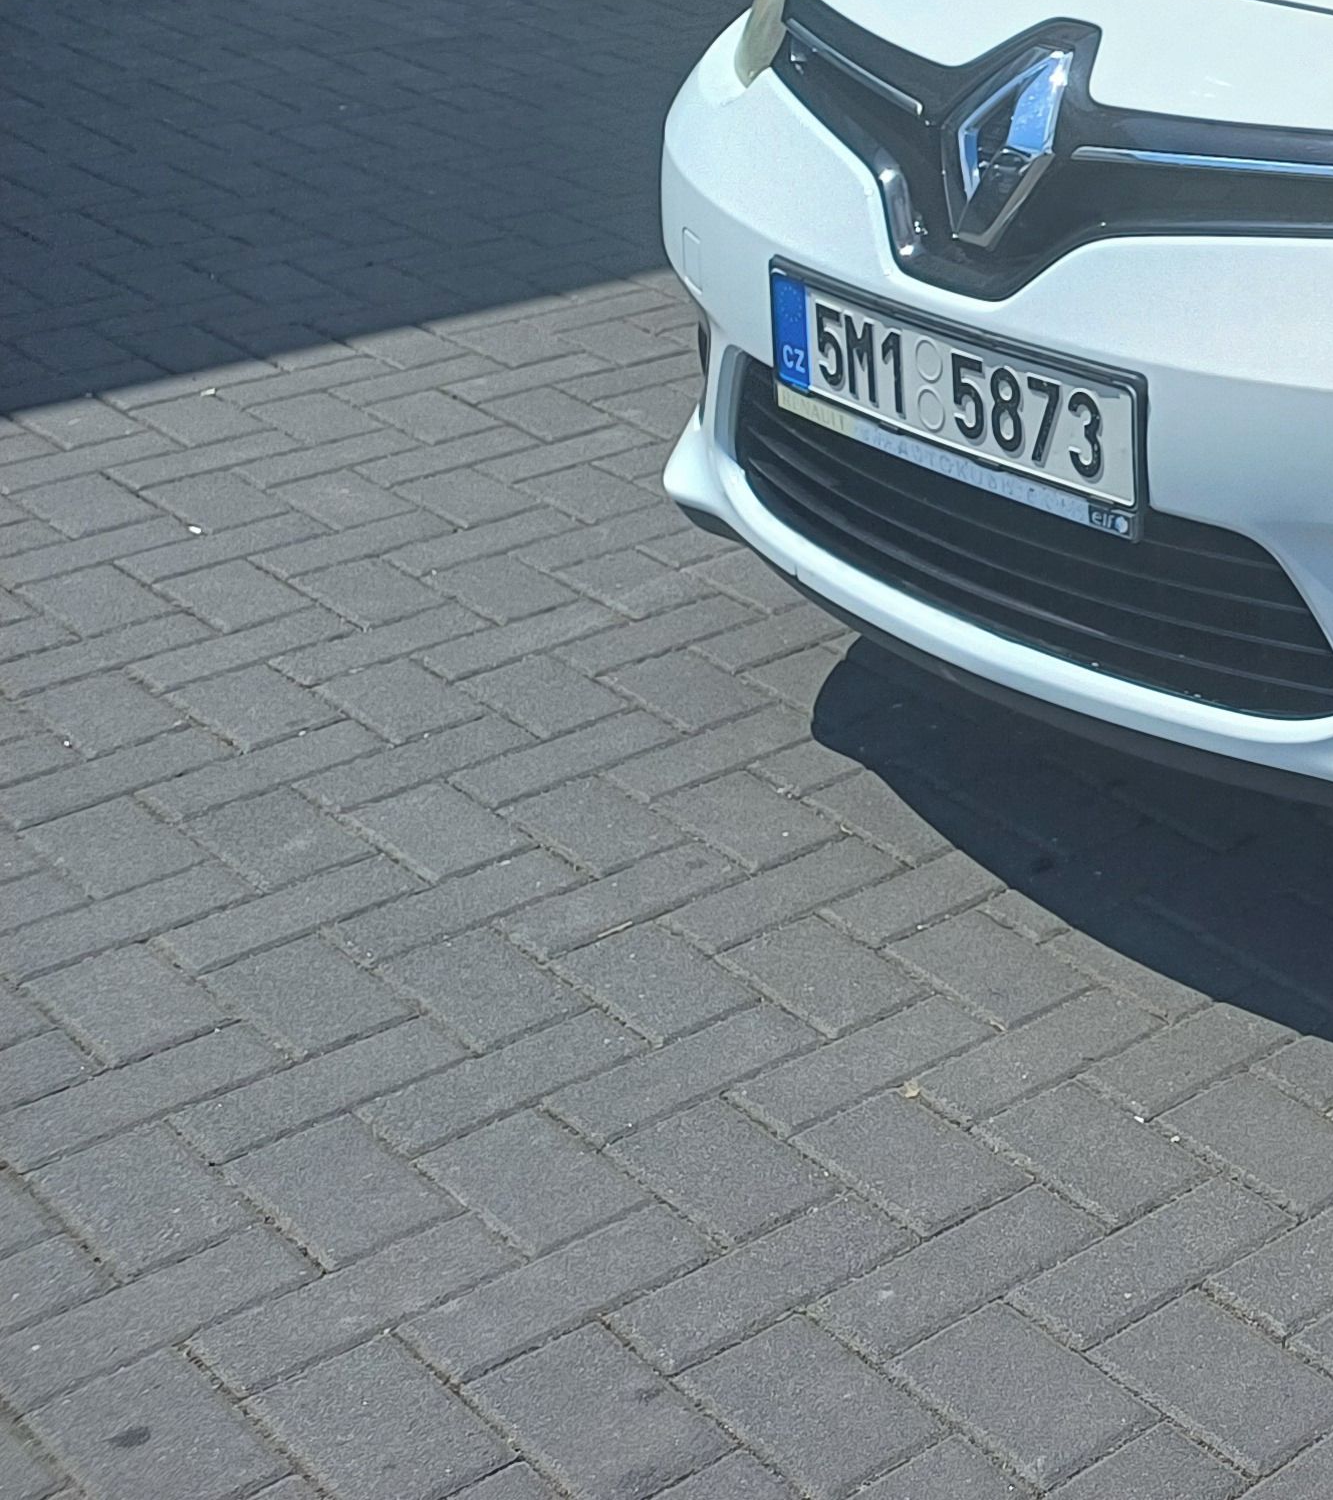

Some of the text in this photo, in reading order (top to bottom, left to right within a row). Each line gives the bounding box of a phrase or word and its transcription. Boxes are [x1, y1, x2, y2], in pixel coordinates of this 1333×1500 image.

[783, 343, 807, 373] CZ
[814, 302, 1102, 479] 5M1 5873
